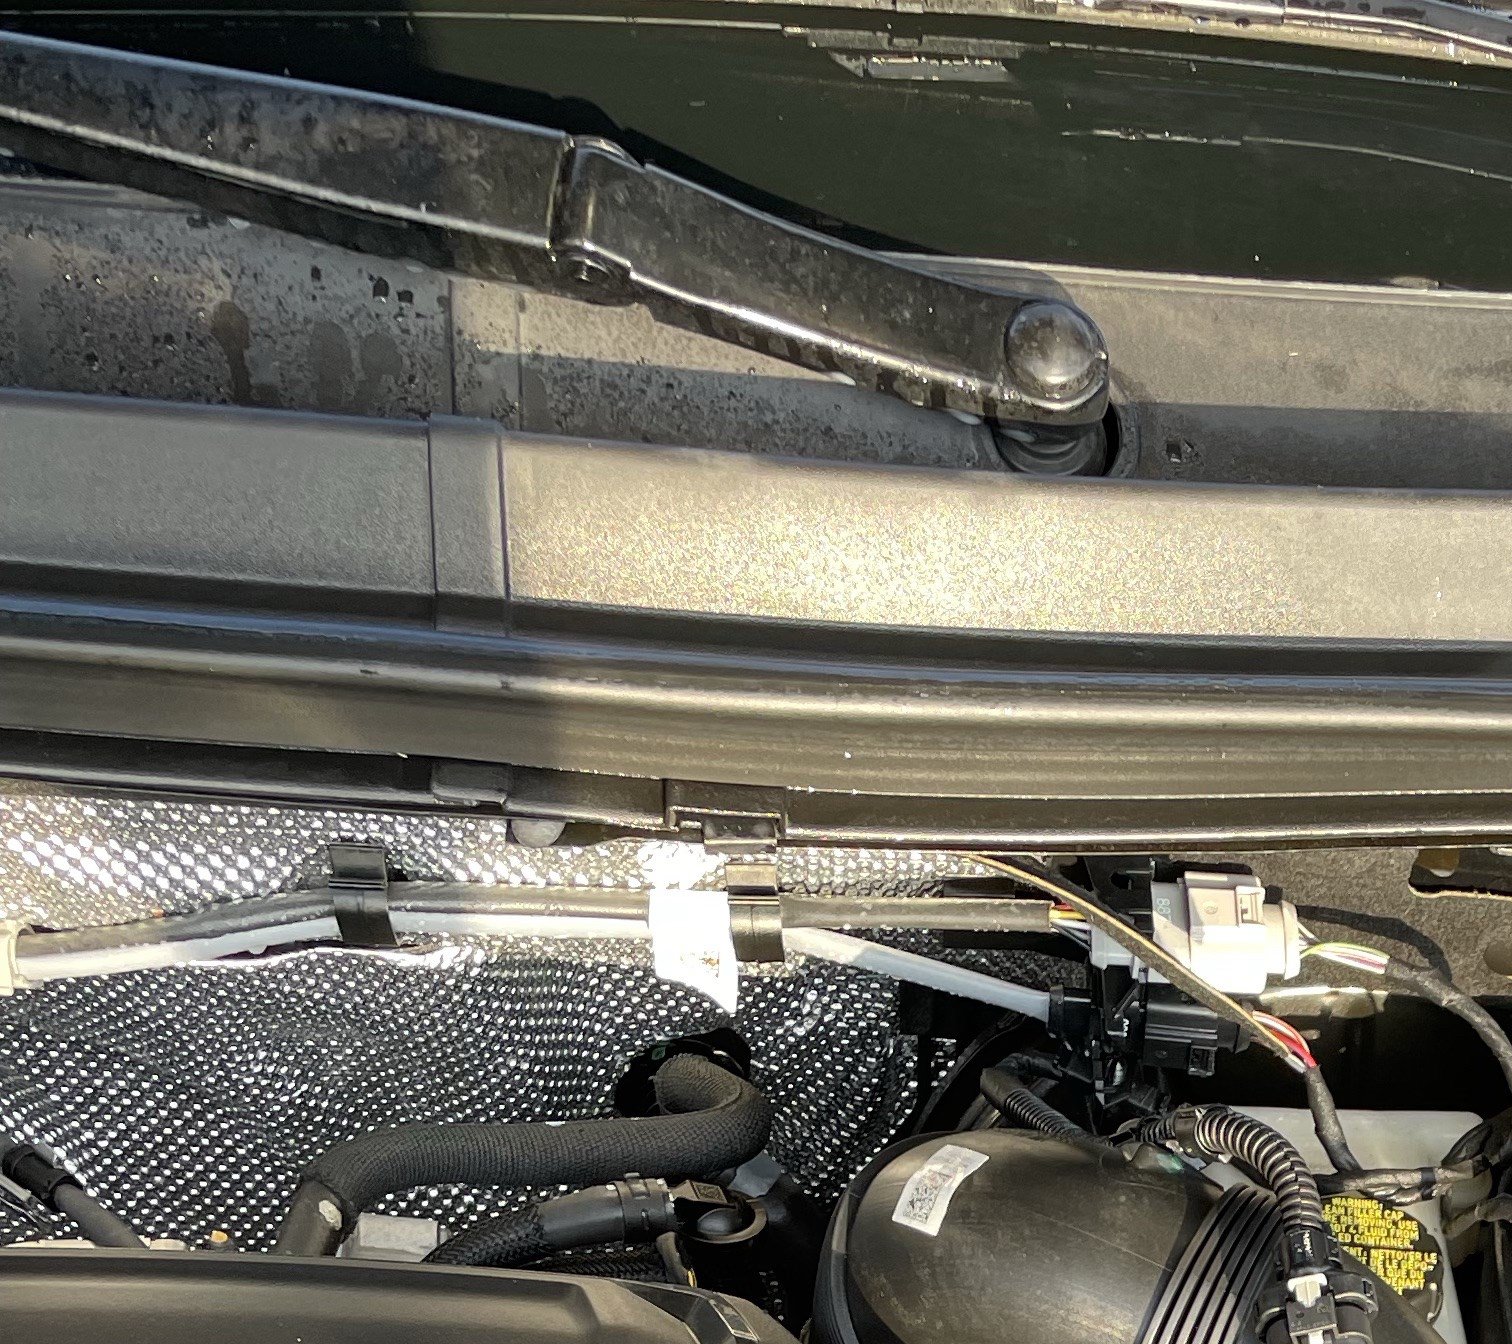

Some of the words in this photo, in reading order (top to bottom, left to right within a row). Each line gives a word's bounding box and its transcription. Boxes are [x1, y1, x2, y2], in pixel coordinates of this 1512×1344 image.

[1348, 1207, 1382, 1218] FILLER
[1384, 1210, 1404, 1221] CAP
[1398, 1220, 1418, 1229] USE
[1358, 1226, 1387, 1236] FLUID
